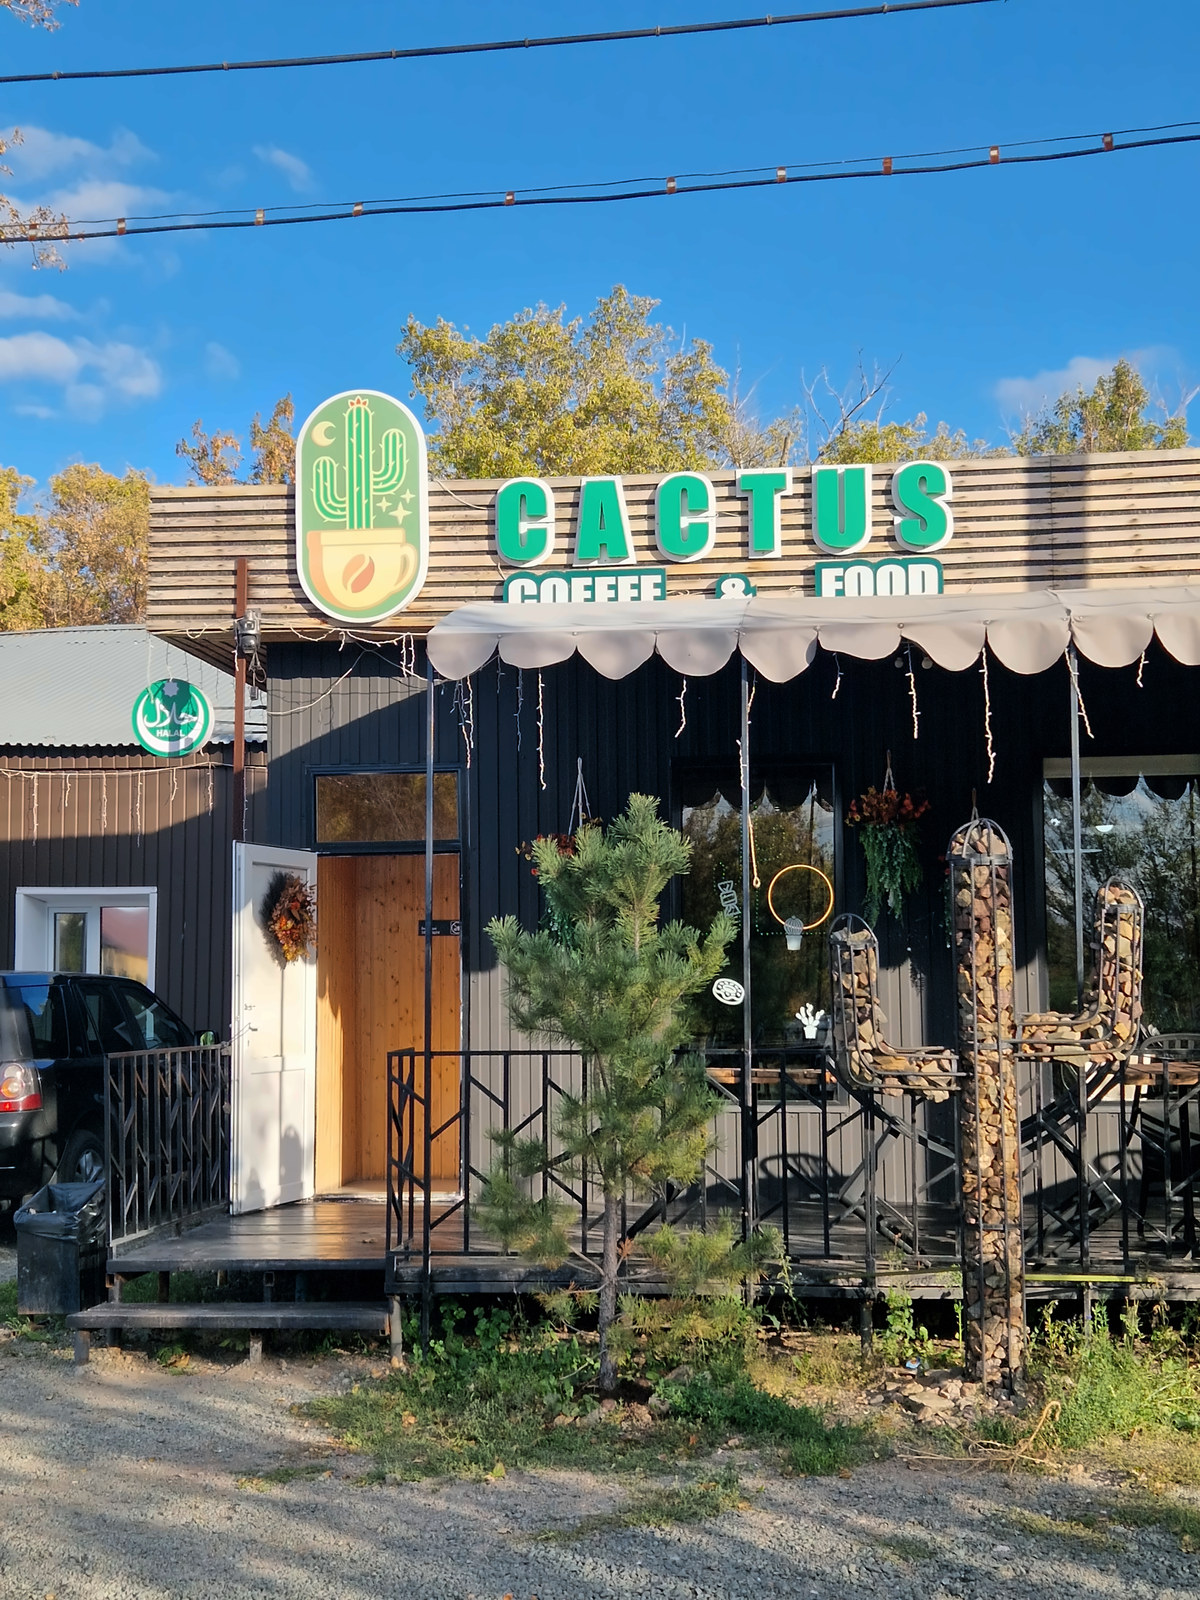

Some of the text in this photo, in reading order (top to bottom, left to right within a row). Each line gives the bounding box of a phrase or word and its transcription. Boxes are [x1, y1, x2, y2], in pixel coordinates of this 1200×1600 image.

[497, 461, 953, 567] CACTUS
[506, 572, 664, 602] COFFEE
[818, 561, 941, 597] FOOD
[144, 698, 198, 728] حلال
[156, 729, 185, 737] HALAL
